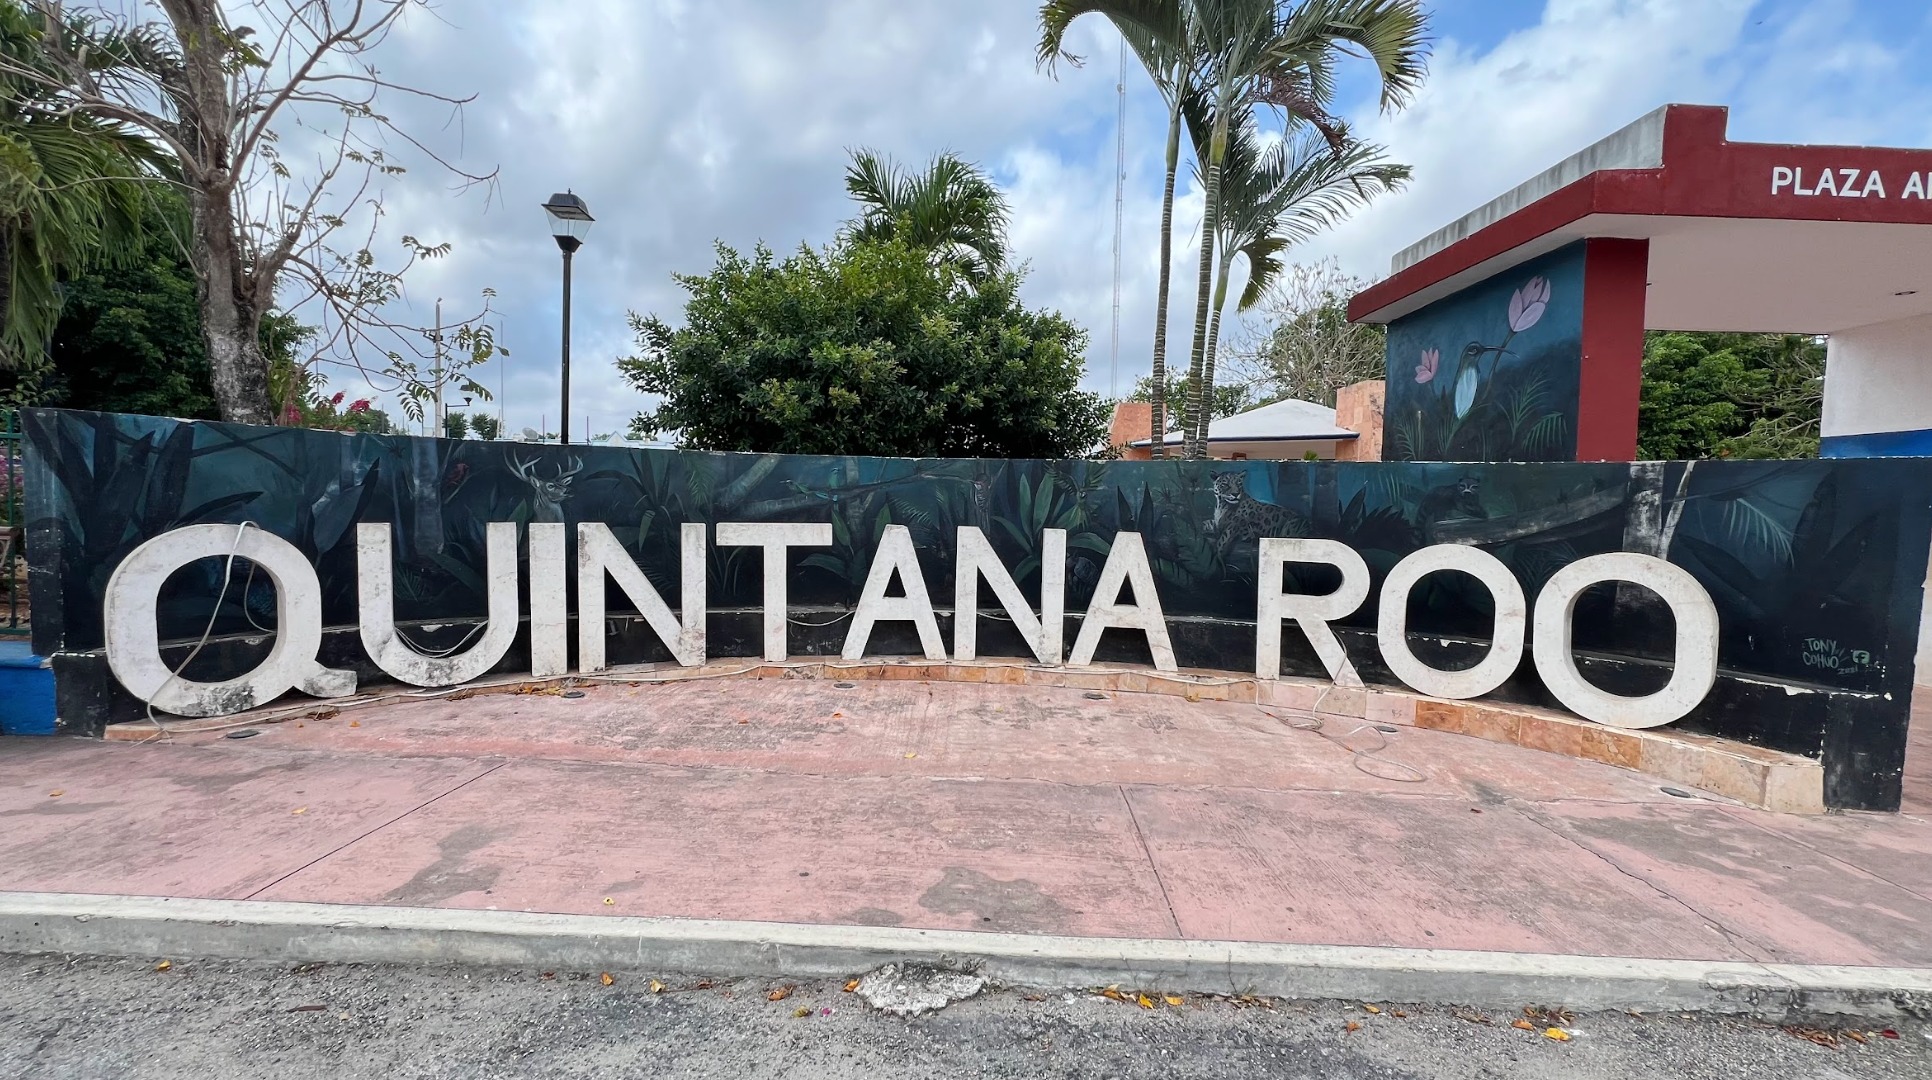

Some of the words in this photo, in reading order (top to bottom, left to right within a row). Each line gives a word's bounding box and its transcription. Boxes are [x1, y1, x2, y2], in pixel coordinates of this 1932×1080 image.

[1771, 166, 1886, 198] PLAZA
[1901, 171, 1932, 199] A
[104, 521, 1178, 717] QUINTANA
[1256, 537, 1718, 729] ROO
[1804, 638, 1837, 655] TONY
